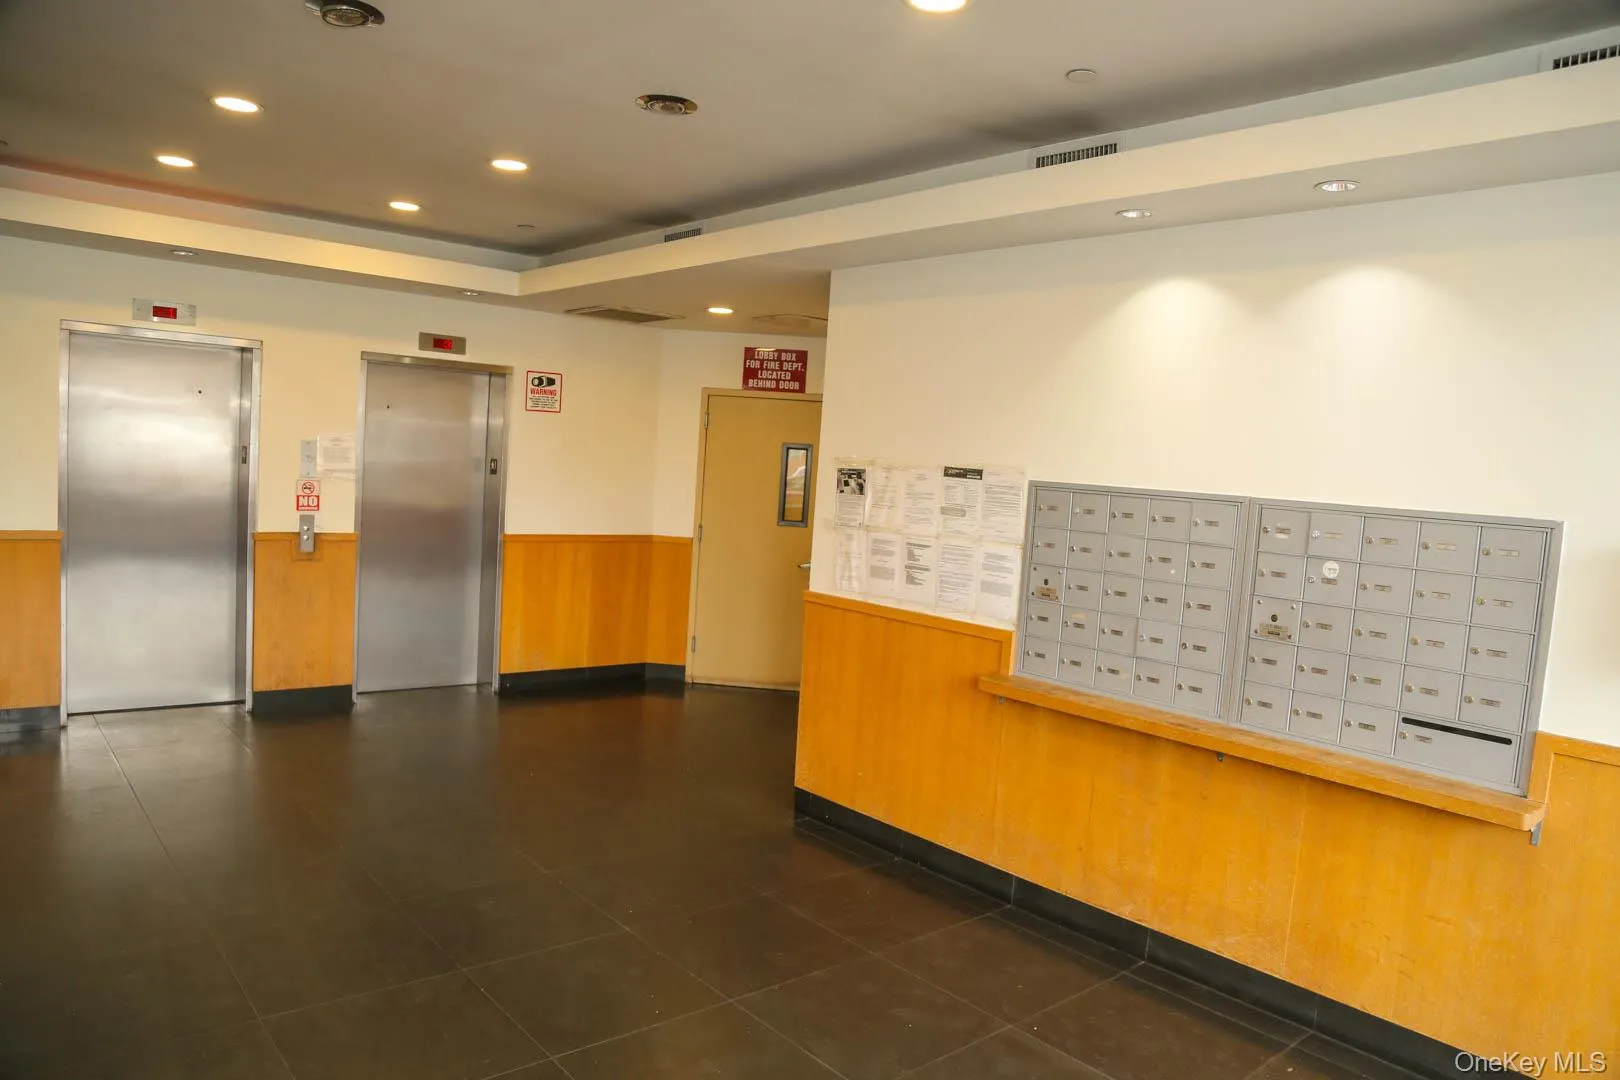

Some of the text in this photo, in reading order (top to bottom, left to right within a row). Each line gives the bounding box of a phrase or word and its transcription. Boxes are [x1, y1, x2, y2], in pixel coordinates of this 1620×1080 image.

[755, 351, 797, 361] LOBBY BOX
[746, 359, 805, 372] FOR FIRE DEPT.
[758, 370, 791, 380] LOCATED
[748, 379, 800, 390] BEHIND DOOR
[530, 388, 557, 396] WARNING
[299, 496, 318, 507] NO
